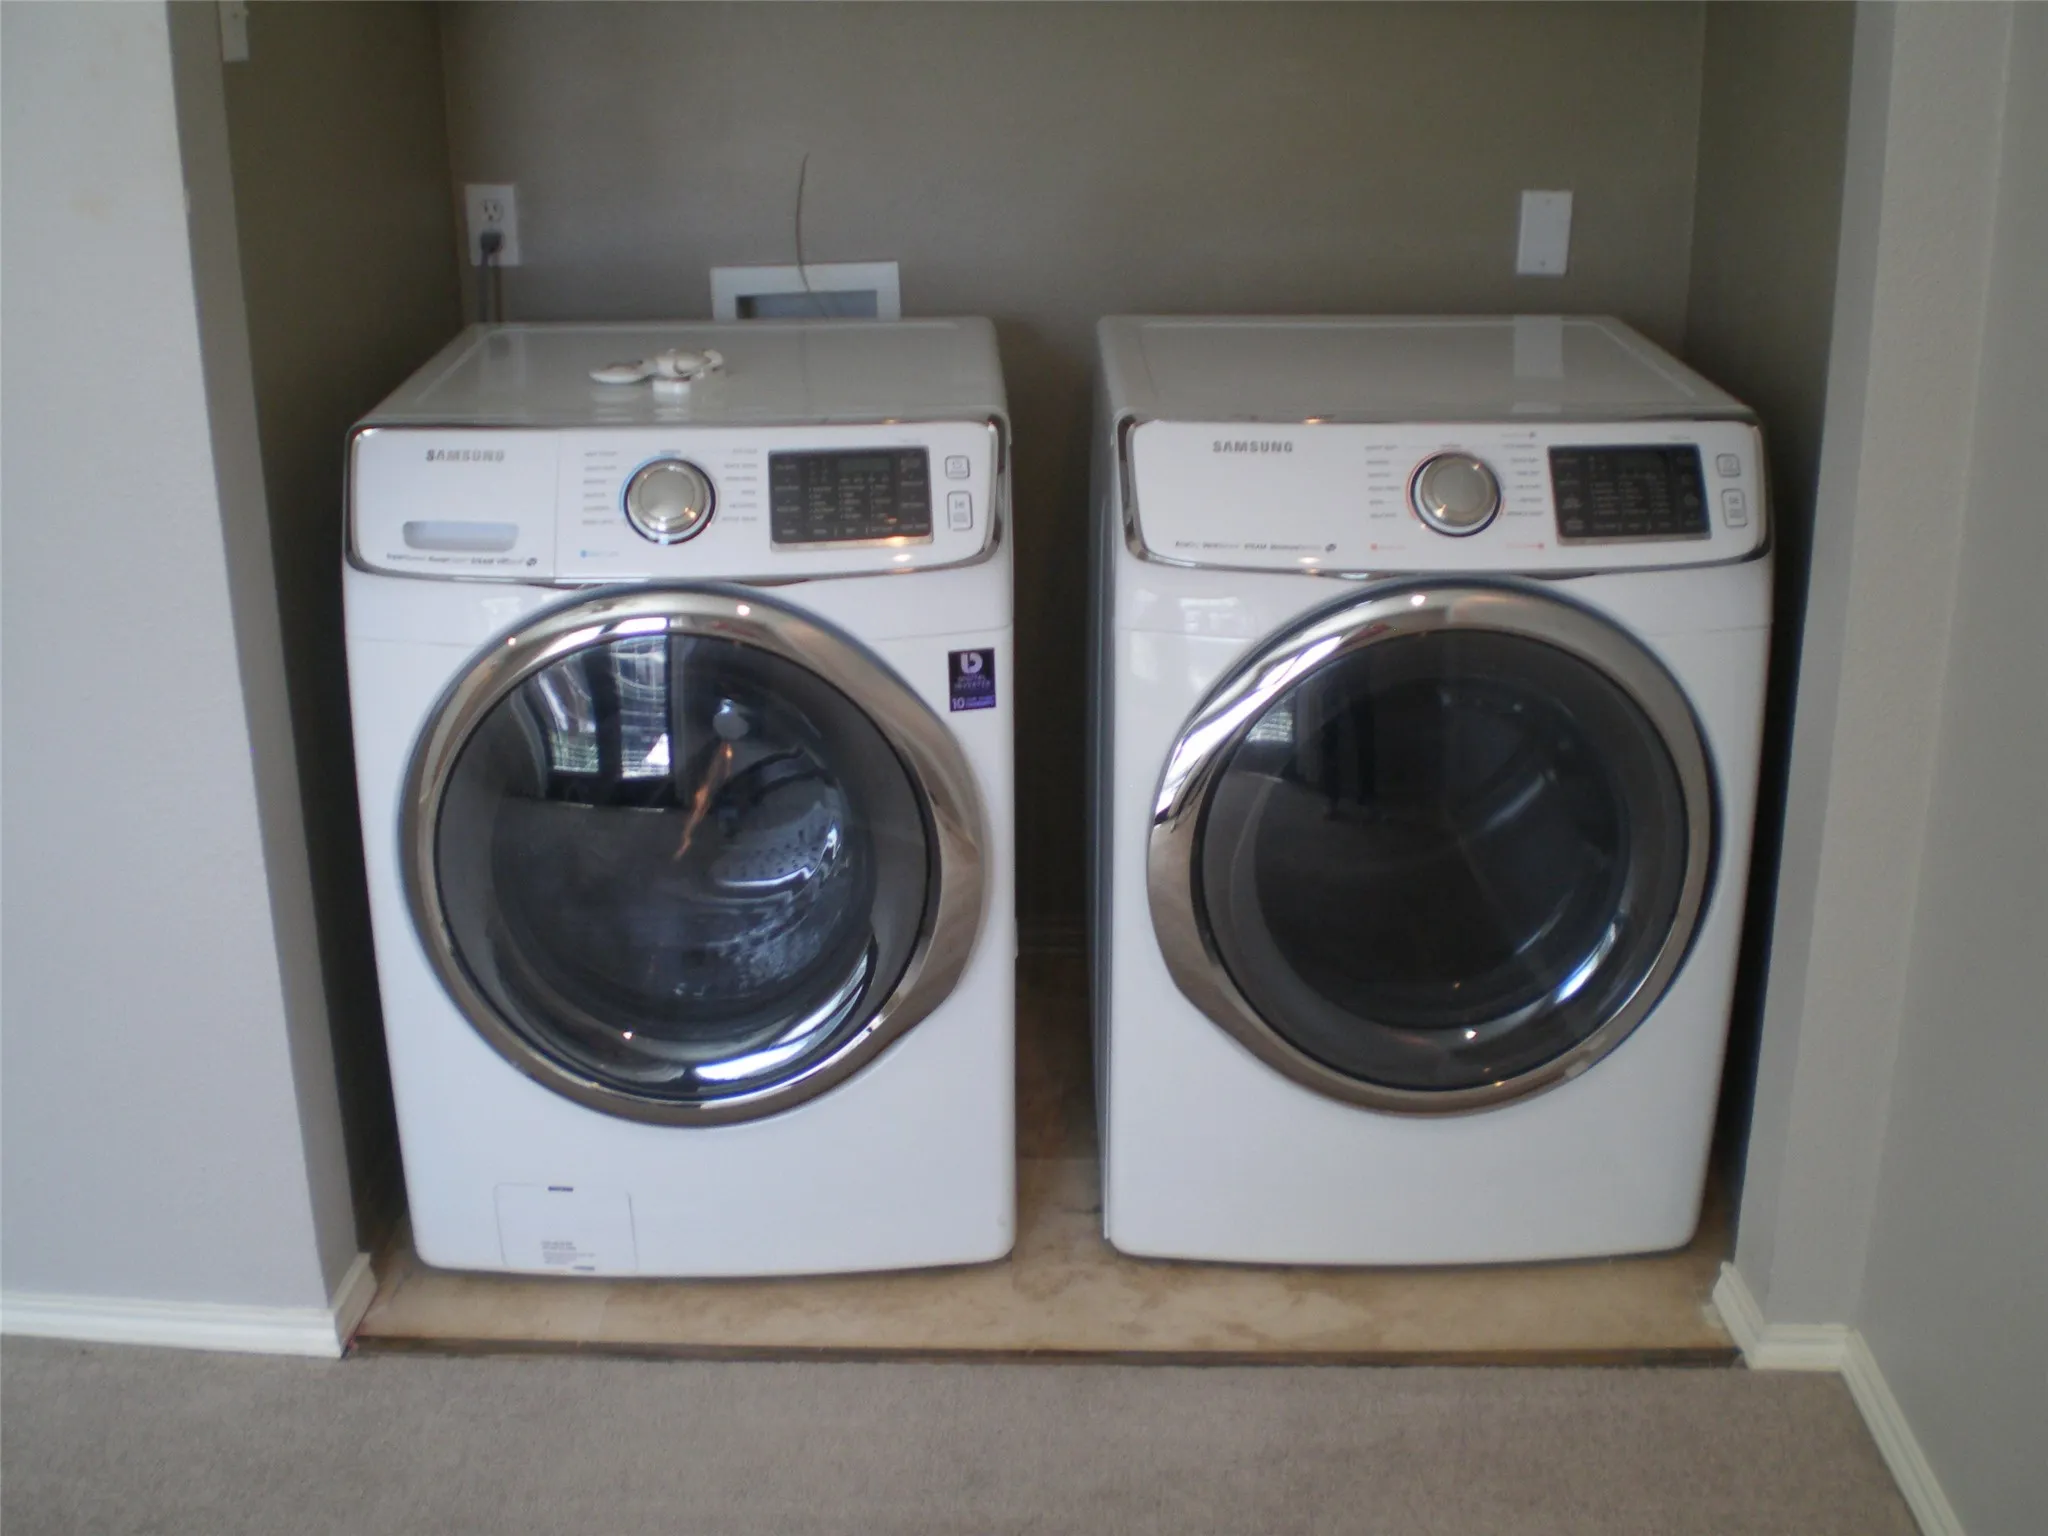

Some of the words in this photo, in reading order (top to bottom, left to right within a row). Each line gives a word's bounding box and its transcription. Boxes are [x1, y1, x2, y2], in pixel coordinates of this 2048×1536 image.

[1213, 440, 1293, 453] SAMSUNG
[426, 449, 505, 463] SAMSUNG
[952, 696, 965, 709] 10
